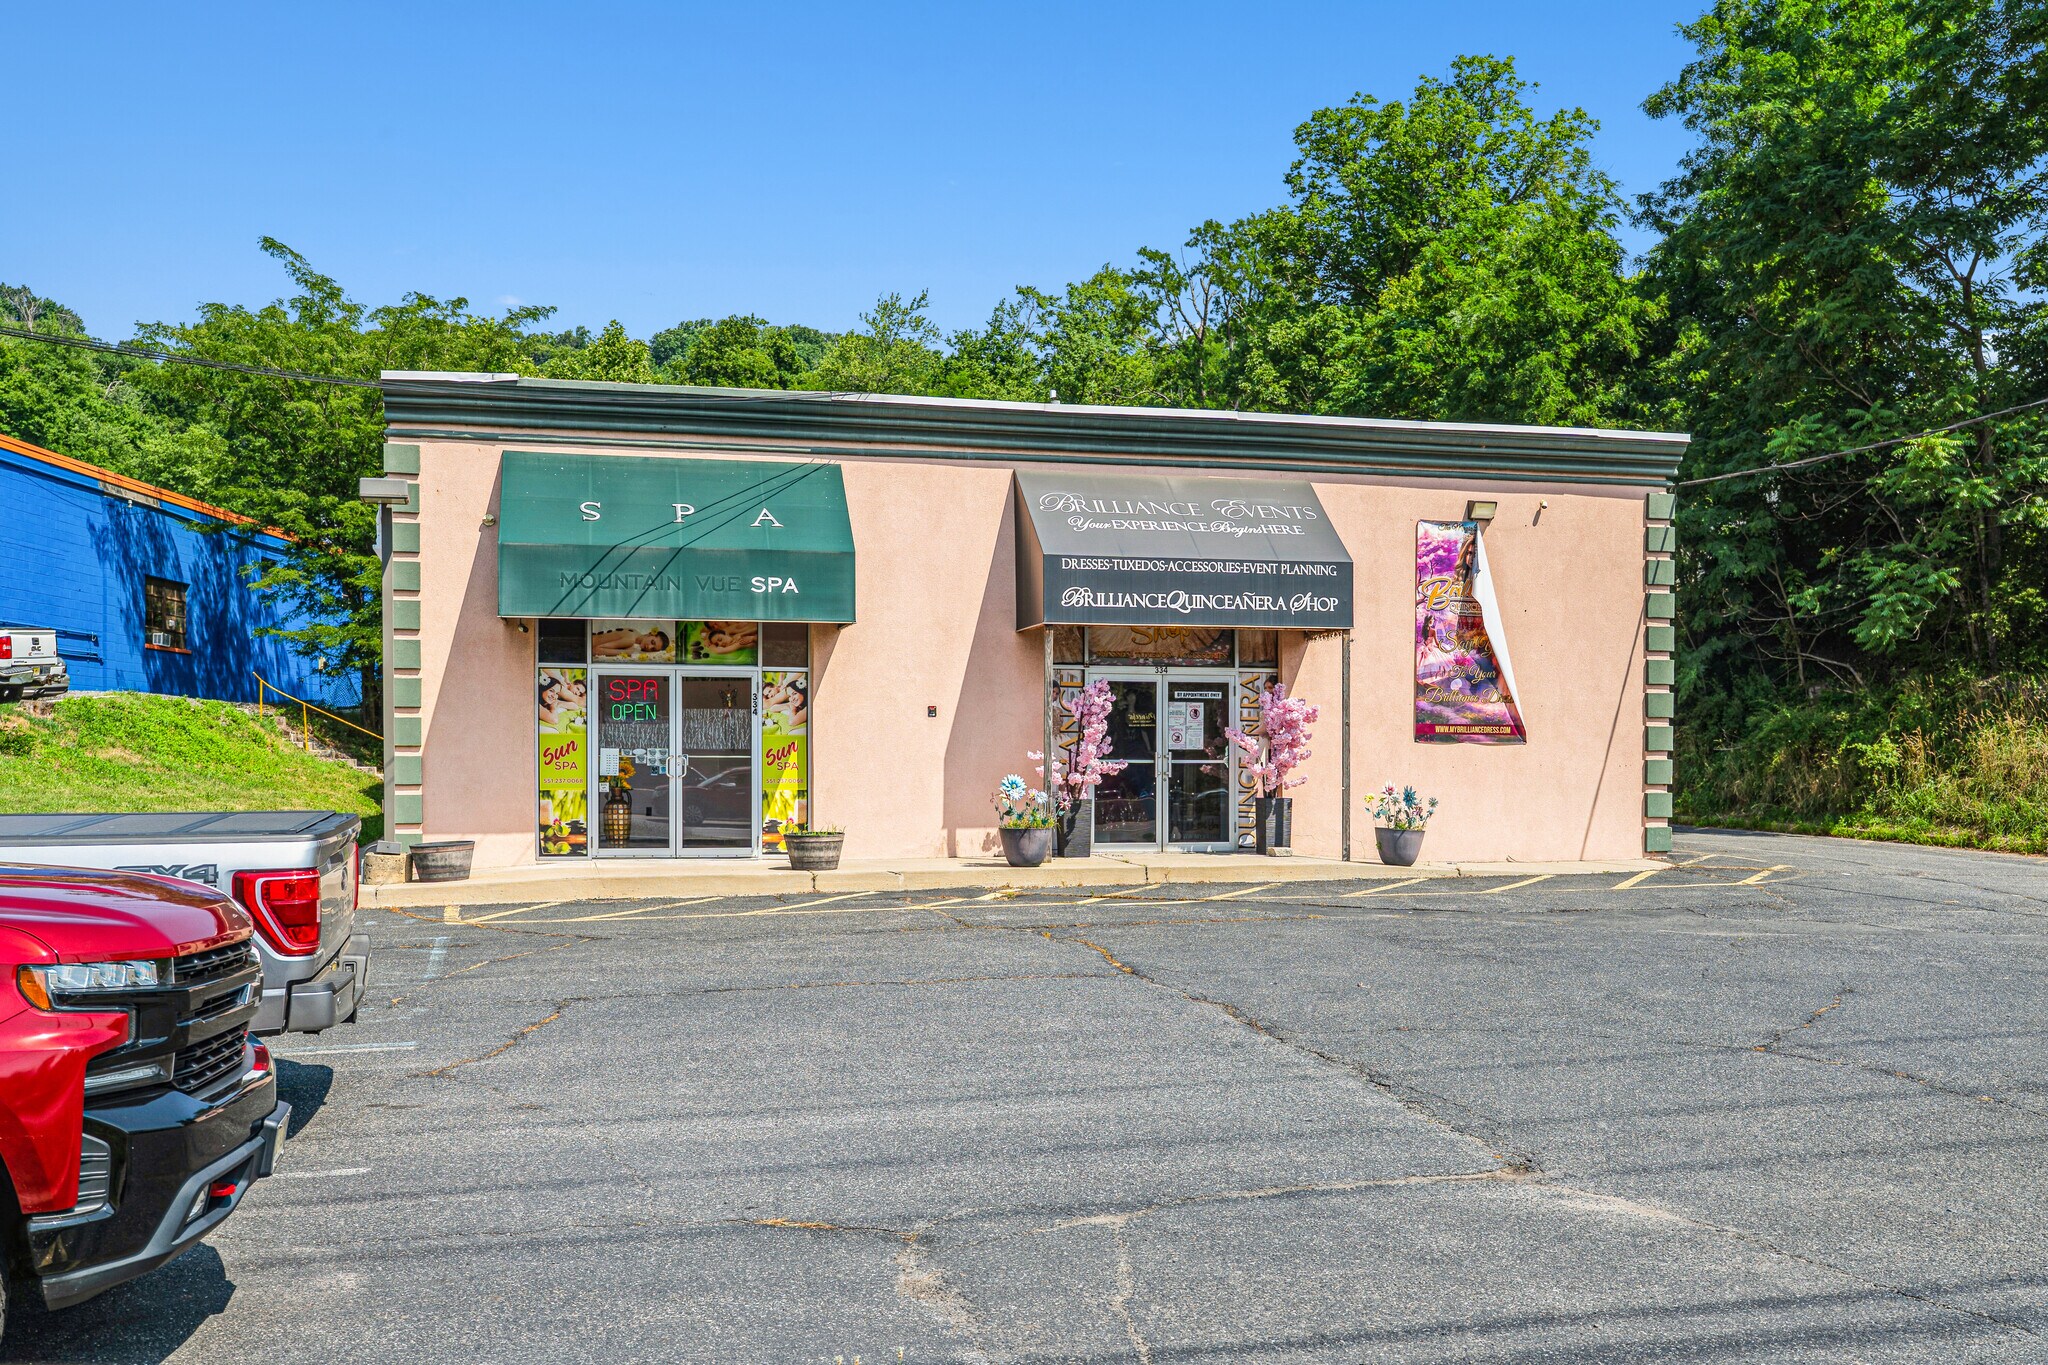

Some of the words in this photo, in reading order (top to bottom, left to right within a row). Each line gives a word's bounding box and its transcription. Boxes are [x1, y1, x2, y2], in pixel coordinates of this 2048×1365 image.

[1039, 492, 1205, 516] BRILLIANCE
[1211, 499, 1317, 520] EVENTS
[1067, 515, 1112, 532] Your
[1111, 519, 1211, 532] EXPERIENCE
[1261, 524, 1305, 535] HERE
[1281, 563, 1338, 576] PLANNING
[560, 572, 681, 592] MOUNTAIN
[695, 576, 741, 592] VUE
[750, 576, 800, 594] SPA
[1289, 591, 1339, 615] SHOP
[1439, 630, 1474, 657] Say
[1154, 665, 1169, 675] 334
[1449, 664, 1466, 679] To
[1468, 664, 1496, 684] Your
[609, 679, 658, 701] SPA
[1425, 687, 1480, 704] Brilliance
[611, 703, 657, 721] OPEN
[1435, 725, 1511, 734] WWW.MYBRILLIANCEDRESS.COM
[543, 740, 578, 766] Sun
[765, 741, 798, 767] Sun
[554, 761, 578, 771] SPA
[776, 761, 799, 771] SPA
